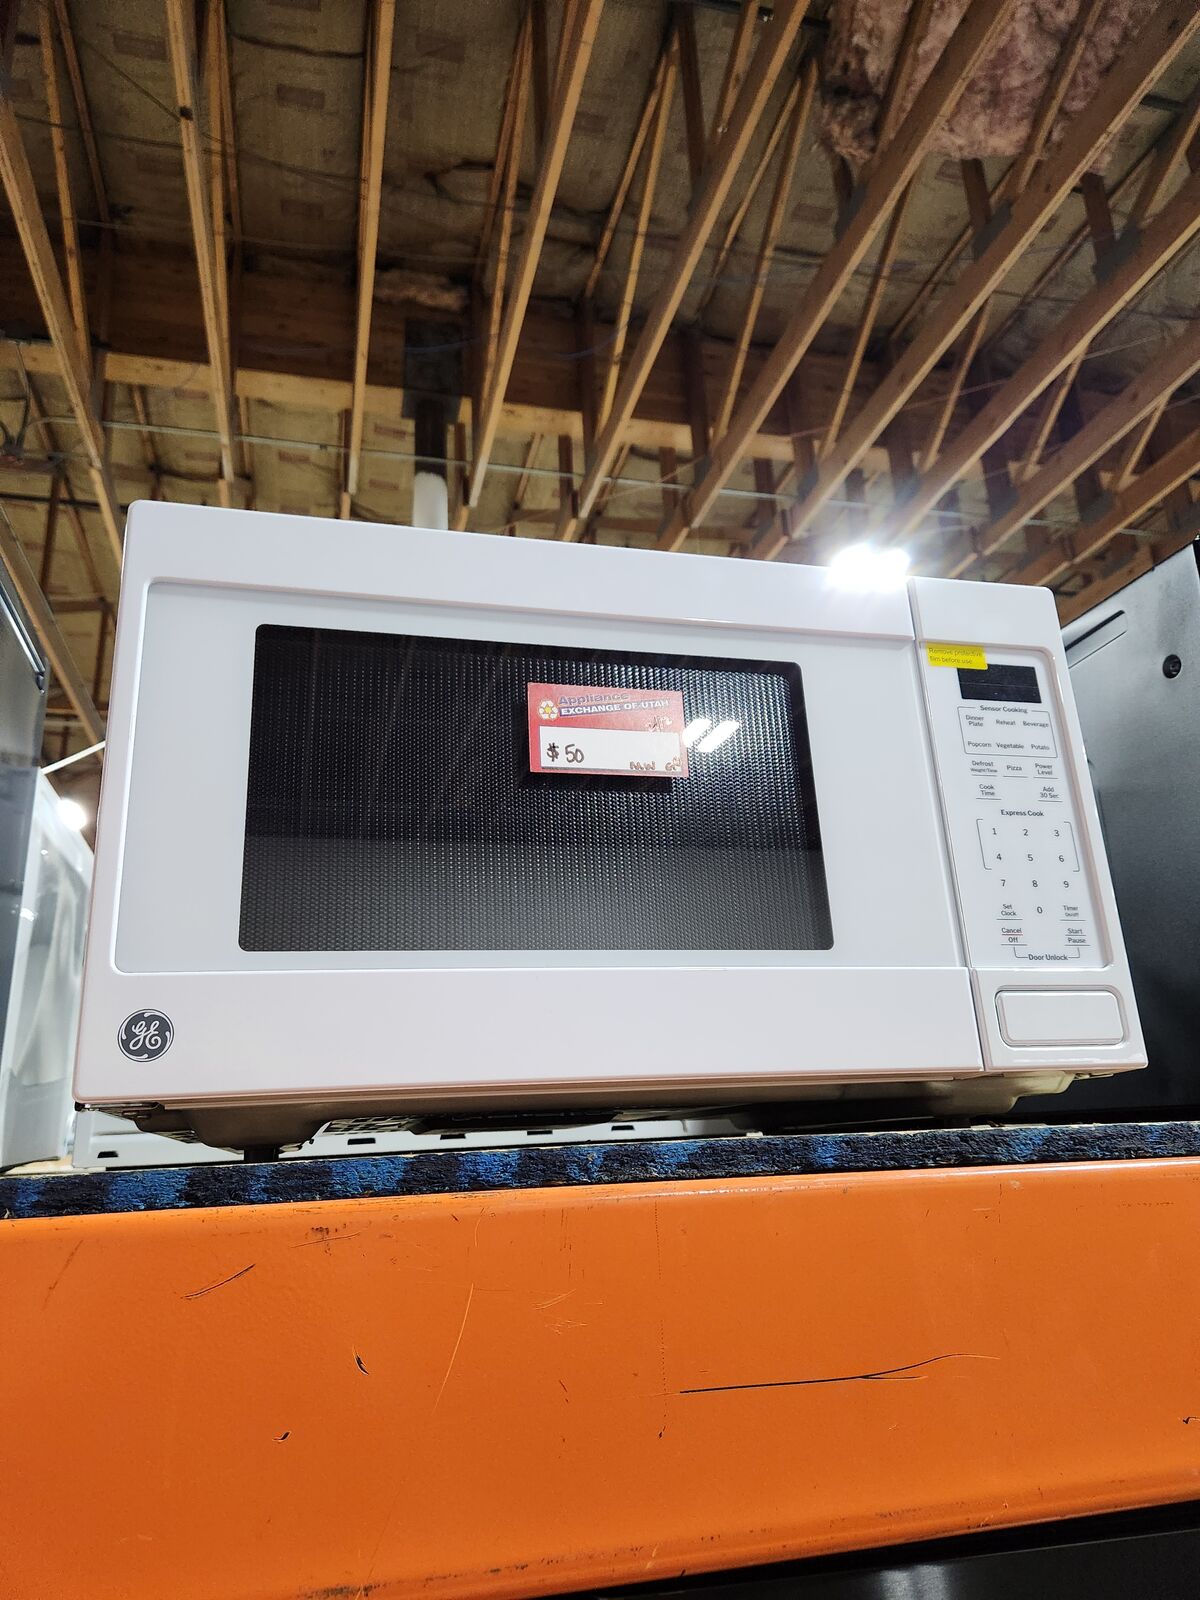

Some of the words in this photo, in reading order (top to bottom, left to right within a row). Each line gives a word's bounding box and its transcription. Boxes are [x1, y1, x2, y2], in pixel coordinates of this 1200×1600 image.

[559, 692, 630, 706] Appliance
[560, 702, 621, 715] EXCHANGE
[625, 701, 639, 710] OF
[641, 699, 670, 709] UTAH
[1002, 706, 1029, 714] Cooking
[1022, 720, 1050, 728] Beverage
[967, 741, 992, 749] Popcorn
[995, 742, 1025, 750] Vegetable
[546, 742, 560, 762] $
[565, 743, 585, 764] 50
[1000, 809, 1027, 817] Express
[1054, 829, 1060, 837] 3
[996, 853, 1002, 861] 4
[1058, 855, 1065, 863] 6
[1000, 879, 1006, 887] 7
[1032, 880, 1038, 888] 8
[1063, 880, 1070, 888] 9
[1036, 906, 1043, 914] 0
[129, 1020, 162, 1050] GE
